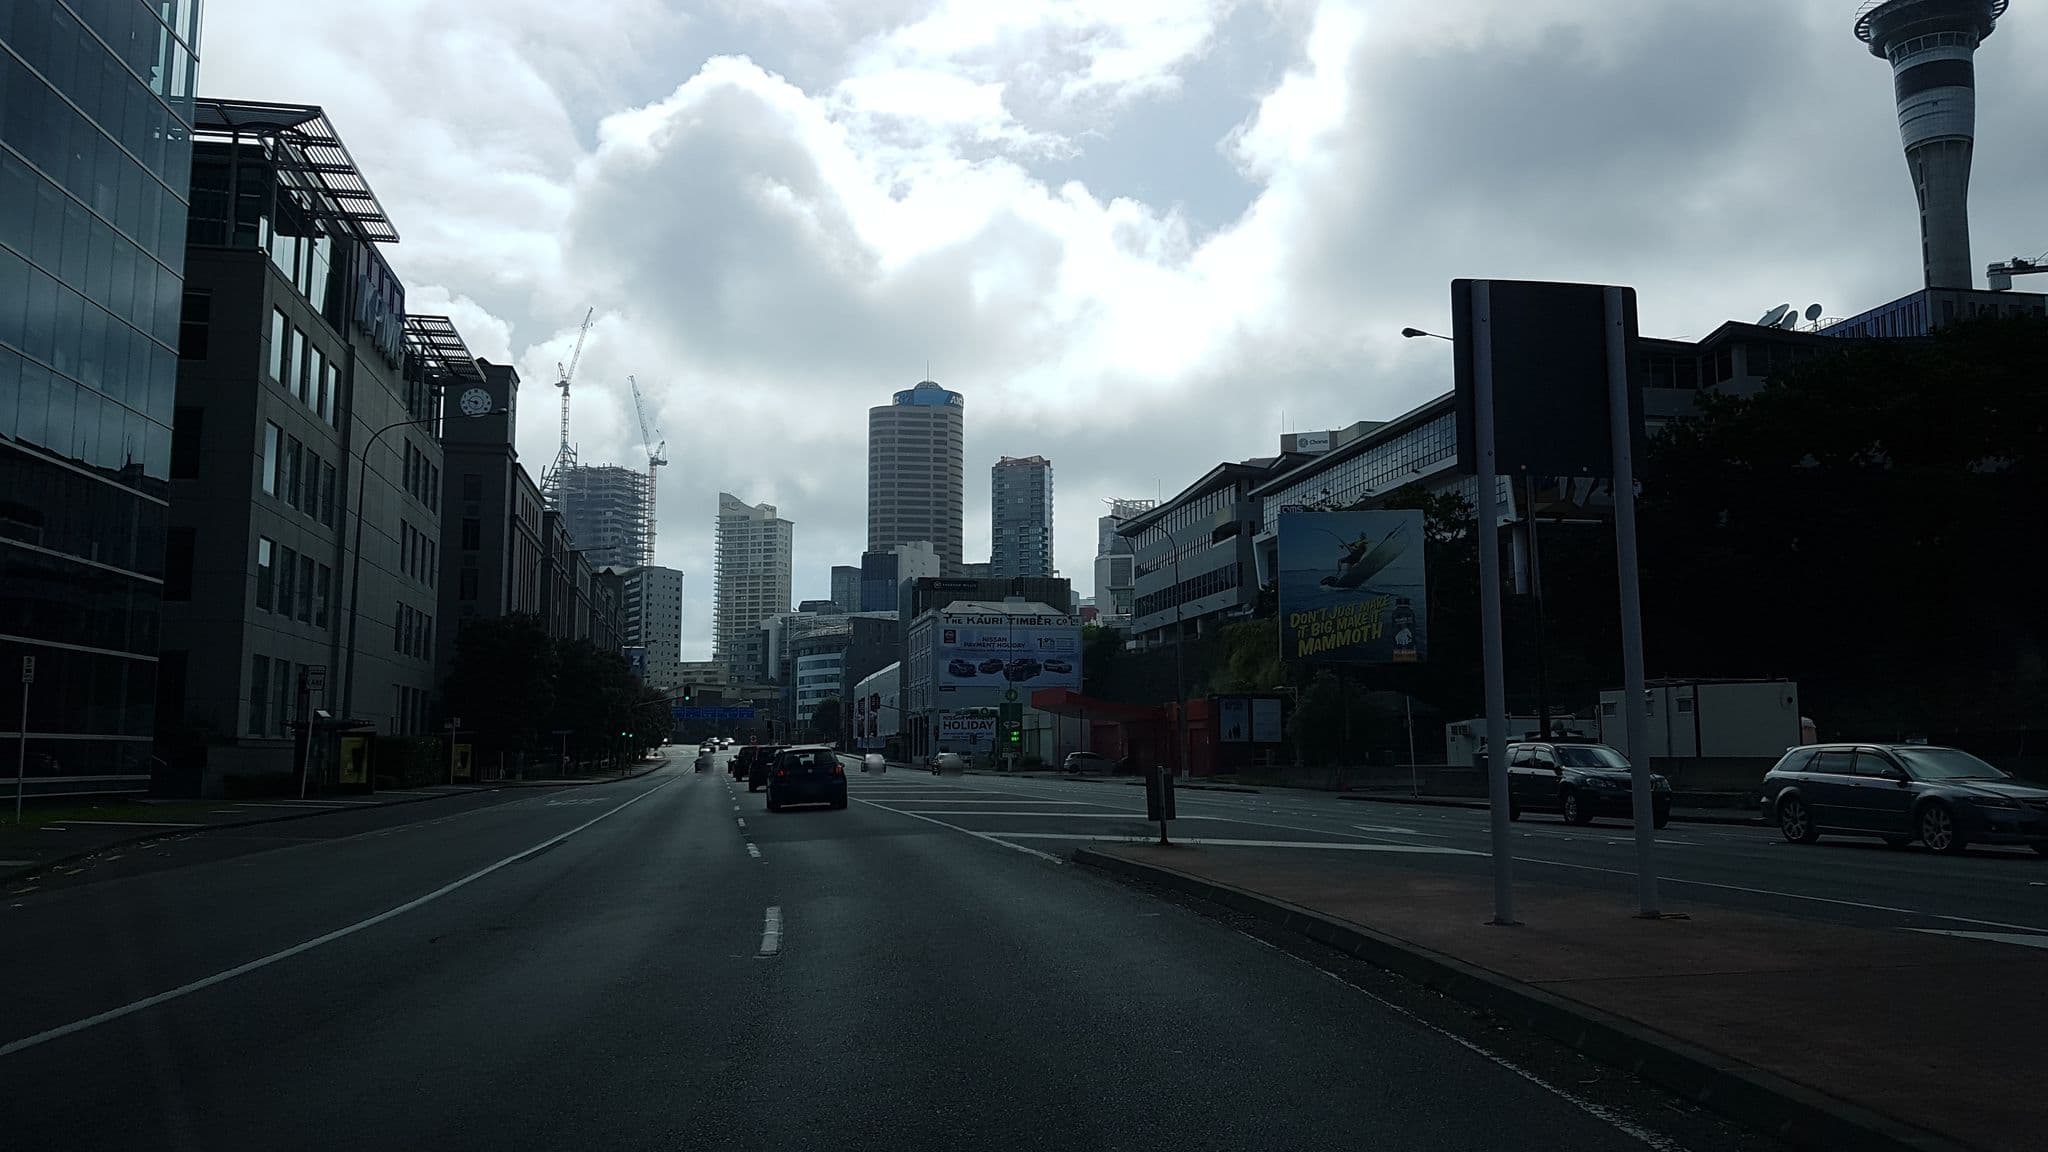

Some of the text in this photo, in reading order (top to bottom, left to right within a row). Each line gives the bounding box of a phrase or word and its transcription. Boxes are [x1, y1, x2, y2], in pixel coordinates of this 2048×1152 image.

[943, 616, 961, 625] THE
[964, 615, 1003, 625] KAURI
[1007, 616, 1052, 626] TIMBER
[1289, 608, 1328, 628] DON'T
[1328, 603, 1355, 620] JUST
[1297, 624, 1309, 639] IT
[1336, 612, 1368, 631] MAKE
[1370, 609, 1383, 624] IT
[1297, 622, 1383, 658] MAMMOTH
[942, 720, 994, 730] HOLIDAY
